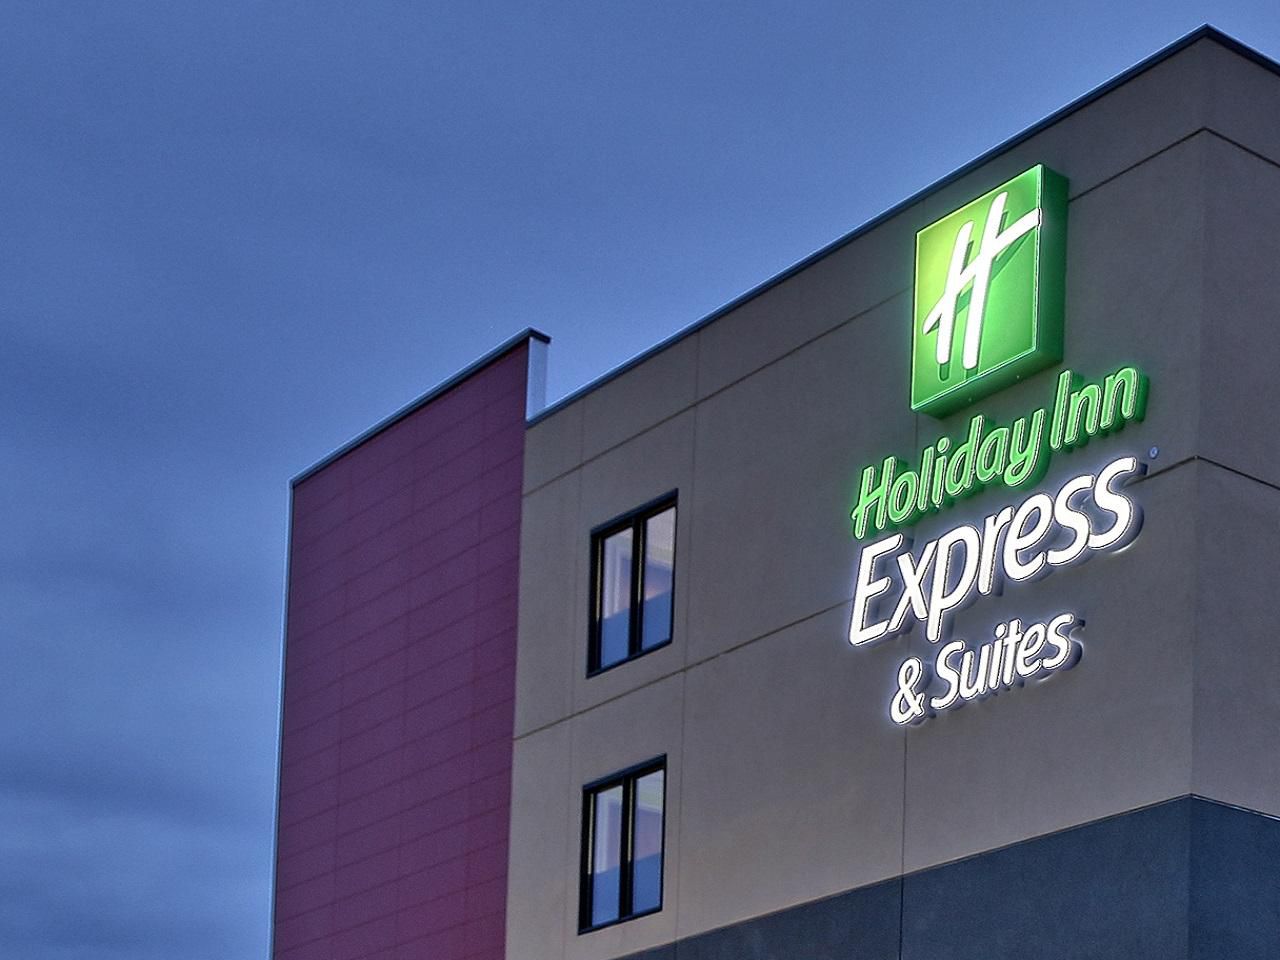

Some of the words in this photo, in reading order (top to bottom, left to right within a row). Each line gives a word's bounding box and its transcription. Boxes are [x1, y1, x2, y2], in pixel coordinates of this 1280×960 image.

[852, 408, 1046, 539] Holiday
[1050, 367, 1138, 450] Inn
[849, 456, 1137, 646] Express
[890, 656, 926, 725] &
[930, 613, 1075, 710] Suites
